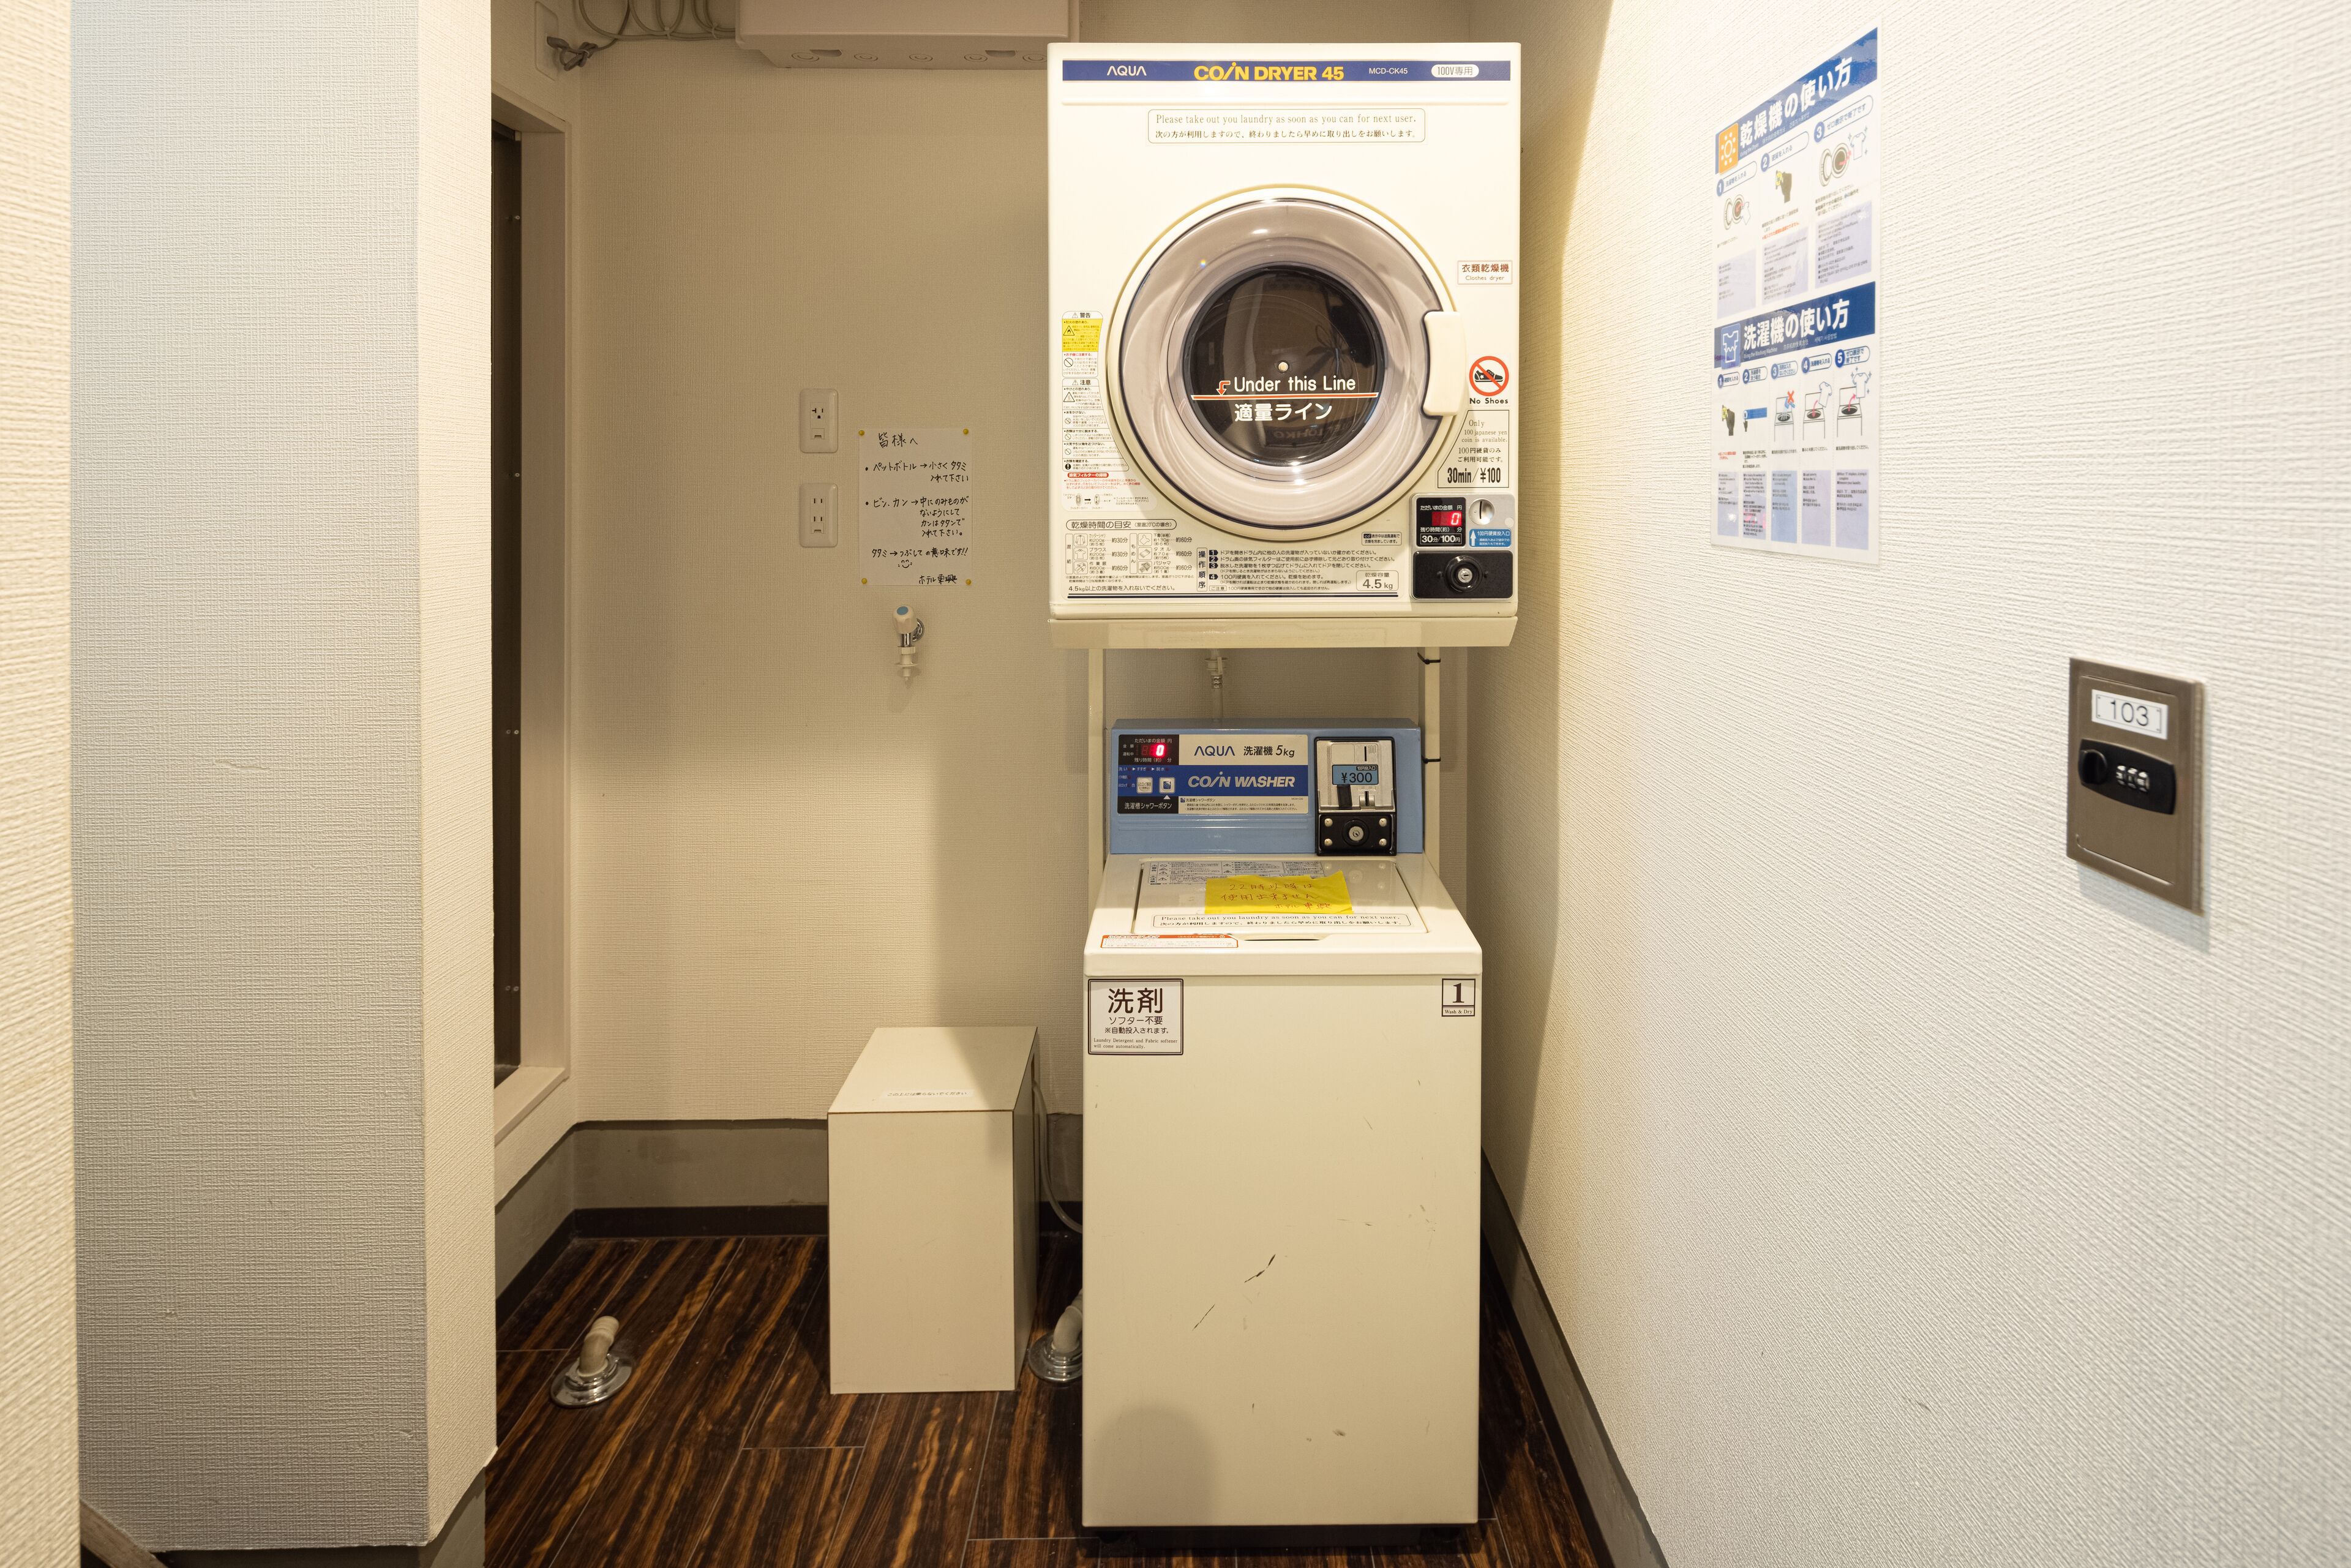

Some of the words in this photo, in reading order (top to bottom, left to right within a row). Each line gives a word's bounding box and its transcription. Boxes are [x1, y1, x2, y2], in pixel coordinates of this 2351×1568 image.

[1107, 65, 1147, 76] AQUA
[1254, 66, 1317, 80] DRYER
[1322, 66, 1344, 80] 45
[1438, 67, 1473, 75] 100V専用
[1740, 56, 1852, 148] 乾燥機の使い方
[1157, 114, 1183, 123] Please
[1186, 114, 1204, 123] take
[1223, 116, 1237, 125] you
[1241, 114, 1273, 125] laundry
[1322, 116, 1336, 125] you
[1357, 114, 1370, 122] for
[1817, 127, 1822, 138] 3
[1462, 264, 1509, 272] 衣類乾燥機
[1744, 299, 1850, 350] 洗濯機の使い方
[1837, 353, 1843, 364] 5
[1803, 361, 1808, 369] 4
[1719, 377, 1723, 386] 1
[1744, 372, 1749, 380] 2
[1234, 377, 1280, 392] Under
[1288, 376, 1316, 391] this
[1323, 376, 1356, 391] Line
[1235, 403, 1332, 422] 適量ライン
[1469, 419, 1485, 428] Only
[878, 432, 918, 448] 皆様へ
[873, 460, 917, 471] ペットボトル
[931, 474, 969, 482] 入れて下さい
[920, 508, 960, 517] ないようにして
[1451, 513, 1459, 525] 0
[872, 549, 887, 558] タタミ
[1363, 579, 1382, 589] 4.5
[2109, 699, 2150, 727] 103
[1156, 745, 1164, 756] 0
[1194, 745, 1235, 756] AQUA
[1243, 746, 1273, 756] 洗濯機
[1275, 745, 1295, 757] 5kg
[1235, 776, 1295, 787] WASHER
[1341, 772, 1372, 783] ¥300
[1452, 983, 1464, 1003] 1
[1108, 988, 1163, 1014] 洗剤
[1109, 1016, 1163, 1025] ソフター不要
